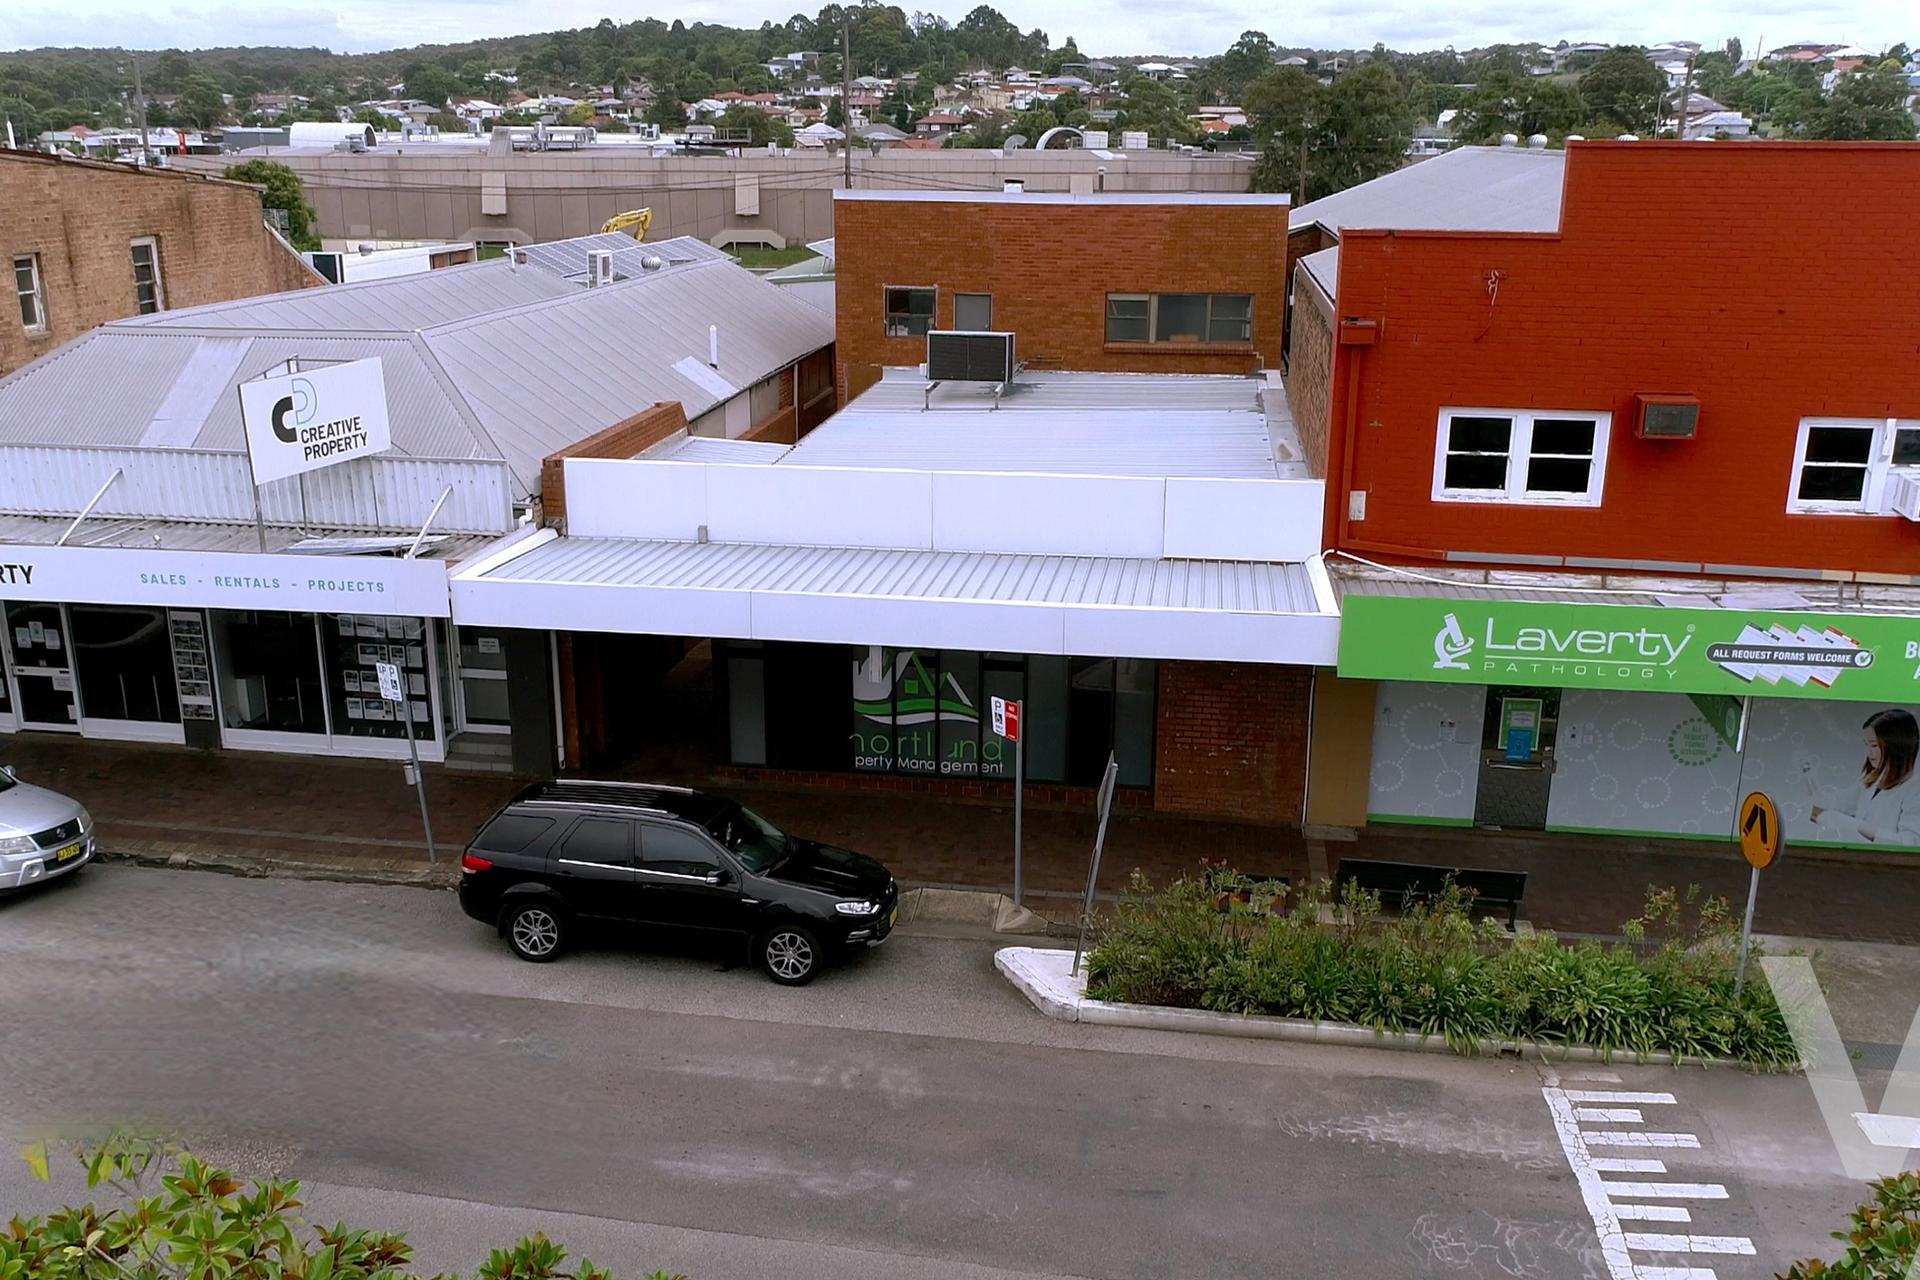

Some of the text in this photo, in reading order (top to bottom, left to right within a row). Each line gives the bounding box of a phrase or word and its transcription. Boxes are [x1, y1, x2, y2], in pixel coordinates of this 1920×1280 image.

[301, 416, 362, 444] CREATIVE
[304, 432, 368, 462] PROPERTY
[140, 573, 187, 585] SALES
[214, 576, 280, 589] RENTALS
[308, 579, 385, 593] PROJECTS
[1485, 617, 1692, 666] Laverty
[1905, 641, 1920, 659] B
[1713, 649, 1851, 663] ALL REQUEST FORMS WELCOME
[1484, 662, 1678, 679] PATHOLOGY
[897, 757, 1004, 774] Management
